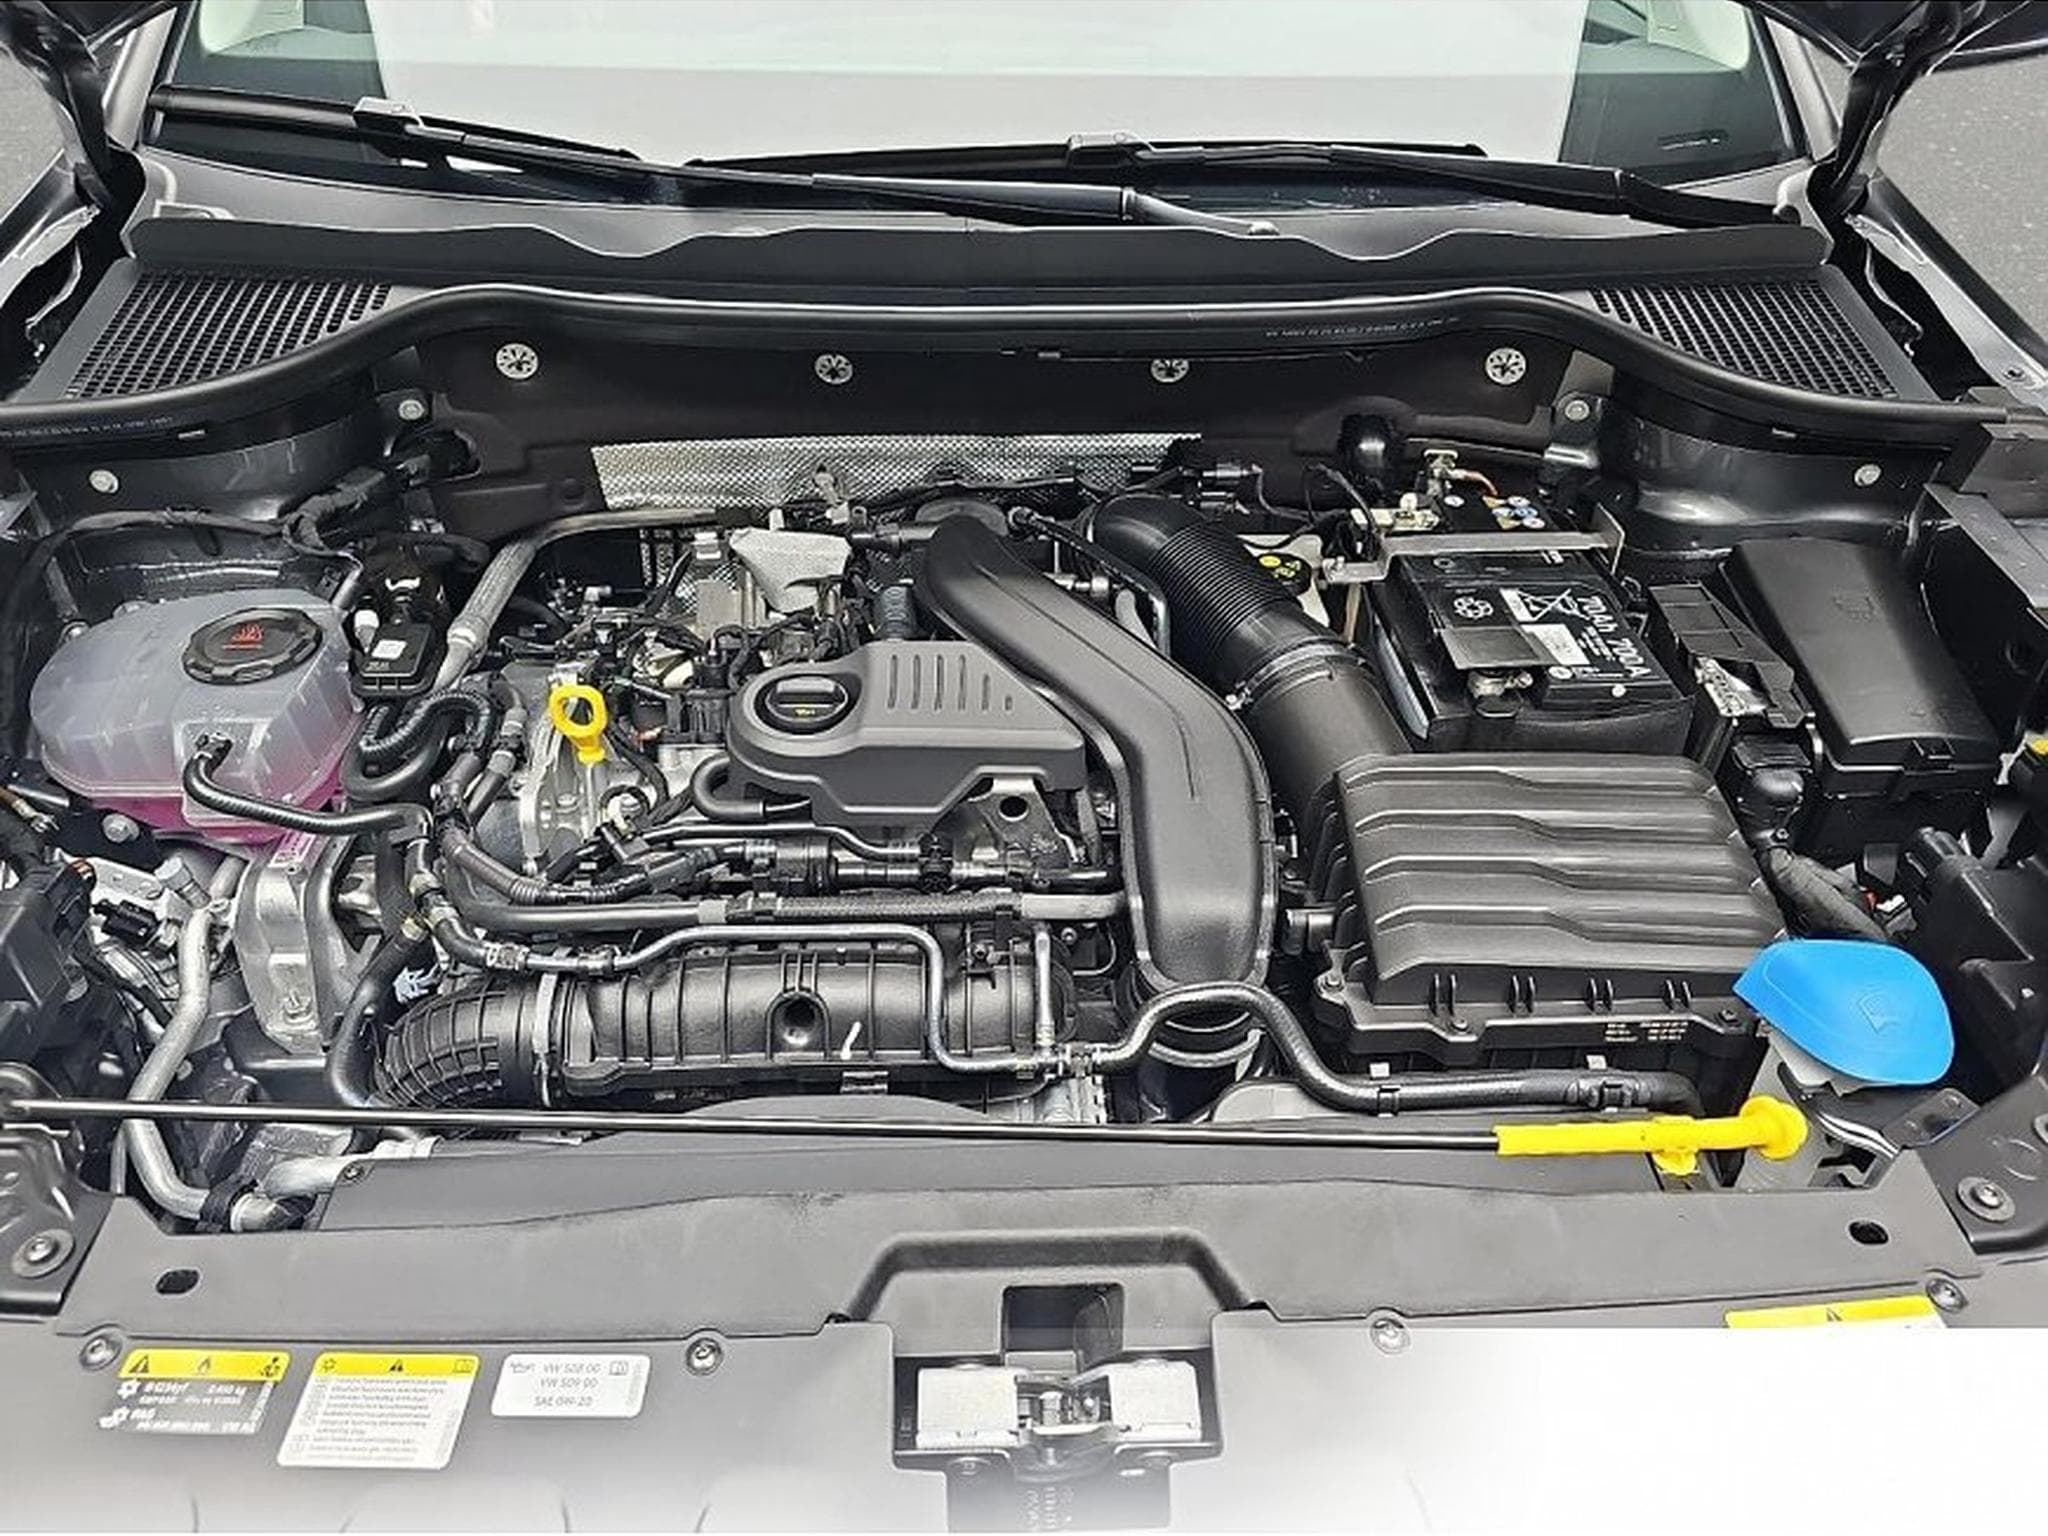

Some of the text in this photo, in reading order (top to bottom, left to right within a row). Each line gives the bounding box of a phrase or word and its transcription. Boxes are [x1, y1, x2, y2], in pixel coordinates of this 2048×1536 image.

[1577, 595, 1619, 633] 70Ah
[543, 1362, 561, 1374] VW
[540, 1377, 559, 1389] VW
